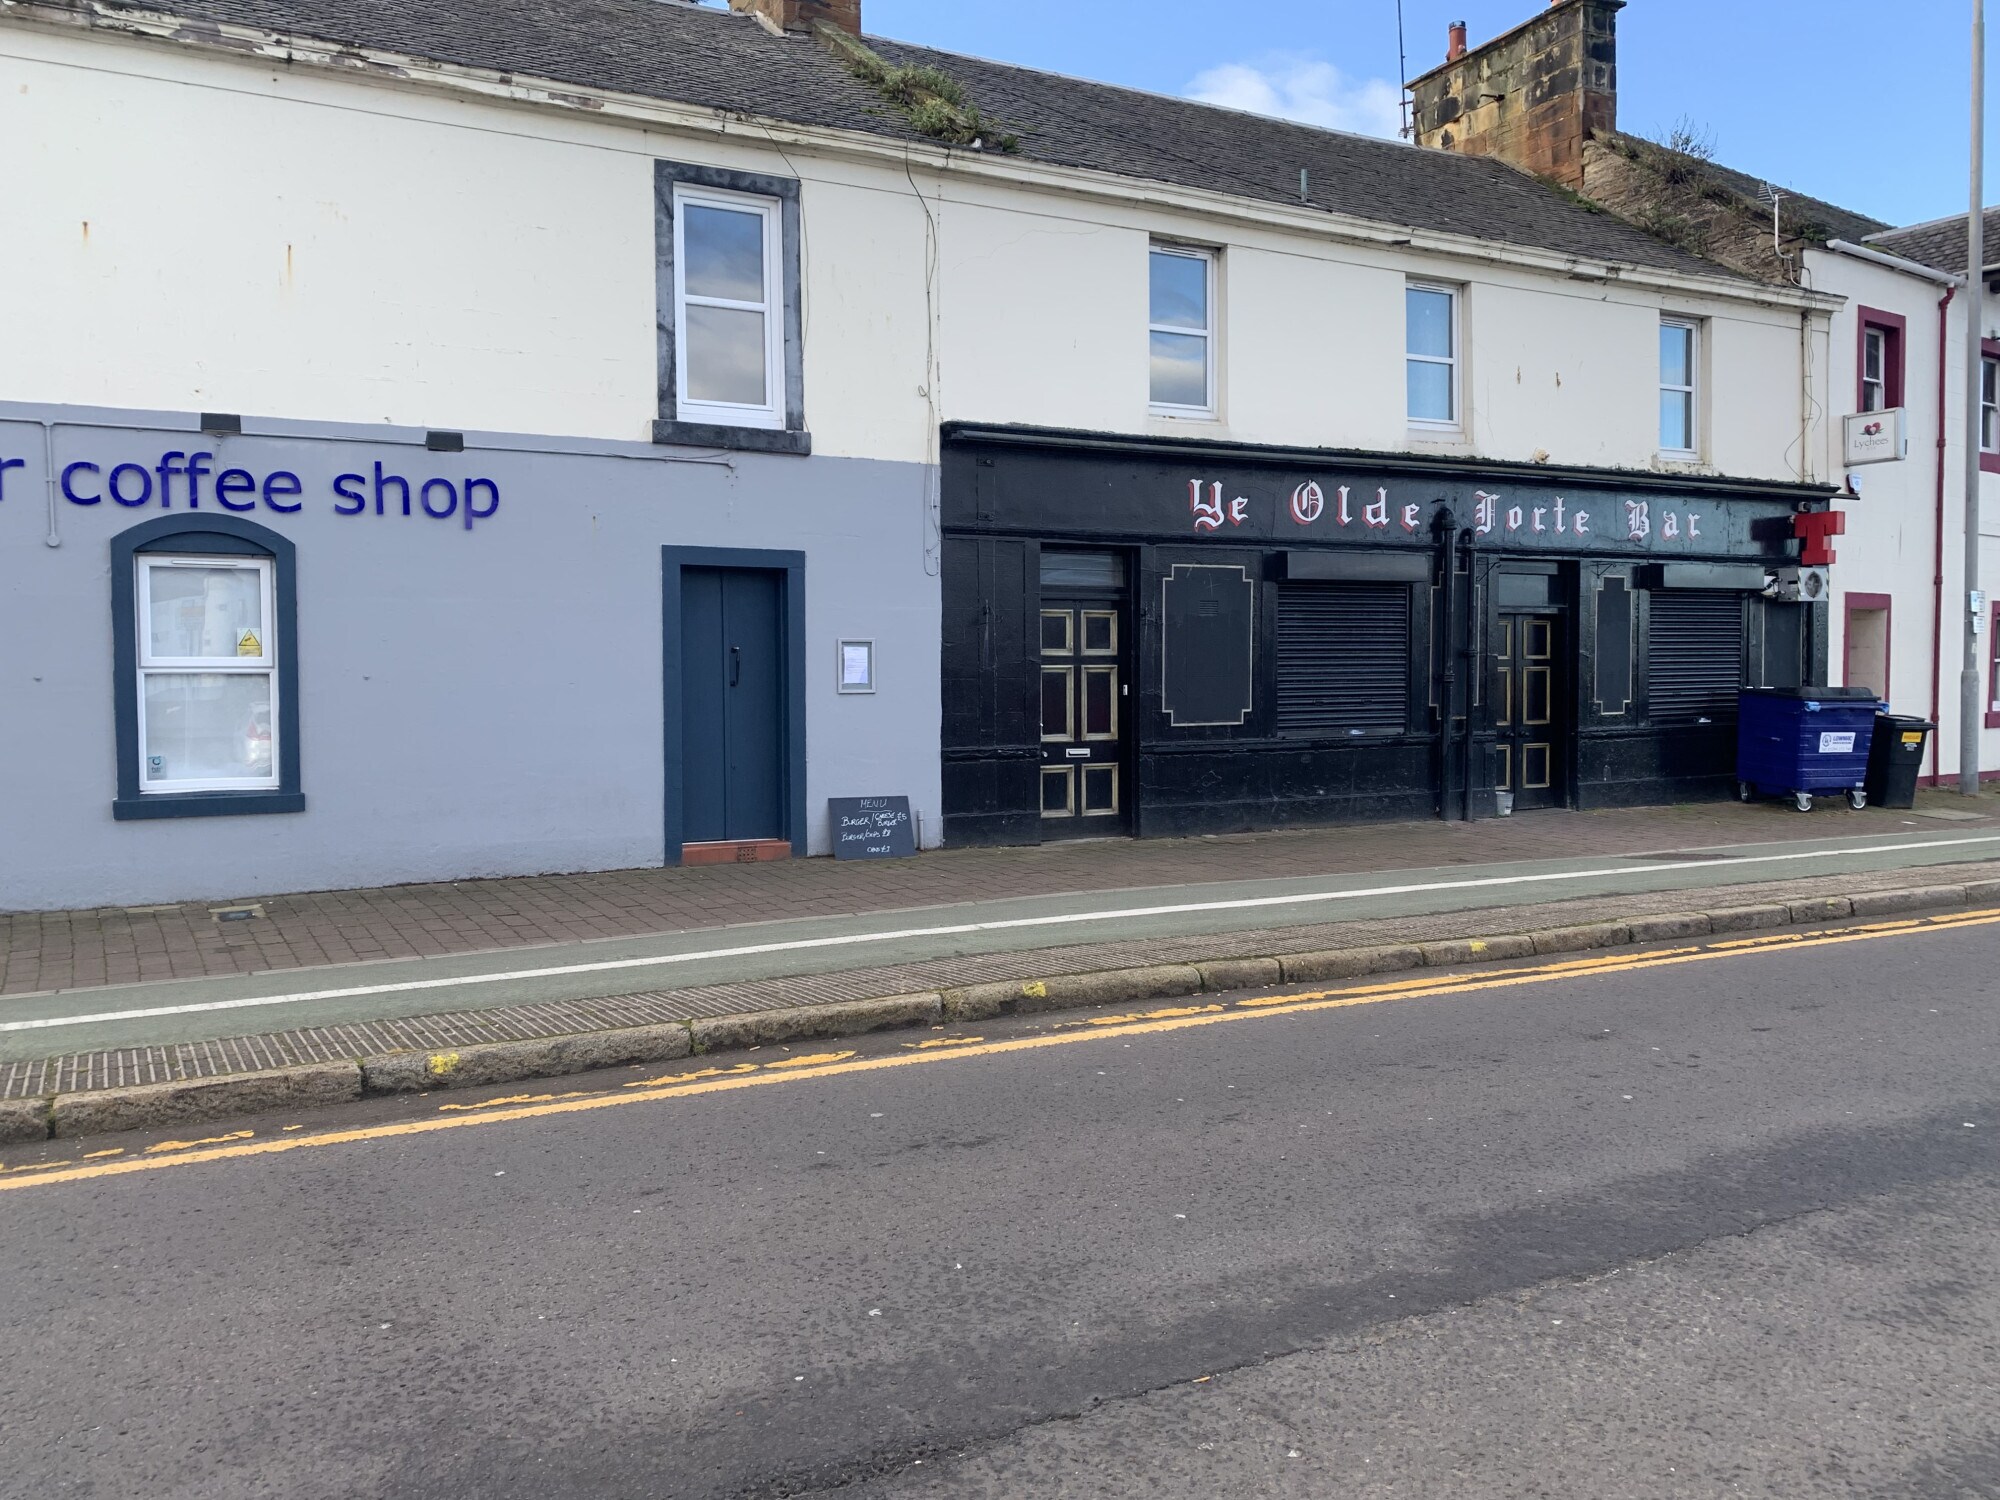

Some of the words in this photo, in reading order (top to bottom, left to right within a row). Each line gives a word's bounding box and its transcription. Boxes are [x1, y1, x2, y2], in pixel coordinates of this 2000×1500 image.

[1853, 434, 1889, 450] Lychees
[61, 451, 303, 514] coffee
[332, 460, 501, 530] shop
[1187, 478, 1249, 532] Ye
[1289, 478, 1421, 532] Olde
[1474, 490, 1591, 538] Forte
[1624, 499, 1702, 542] Bar
[860, 798, 888, 809] MENU
